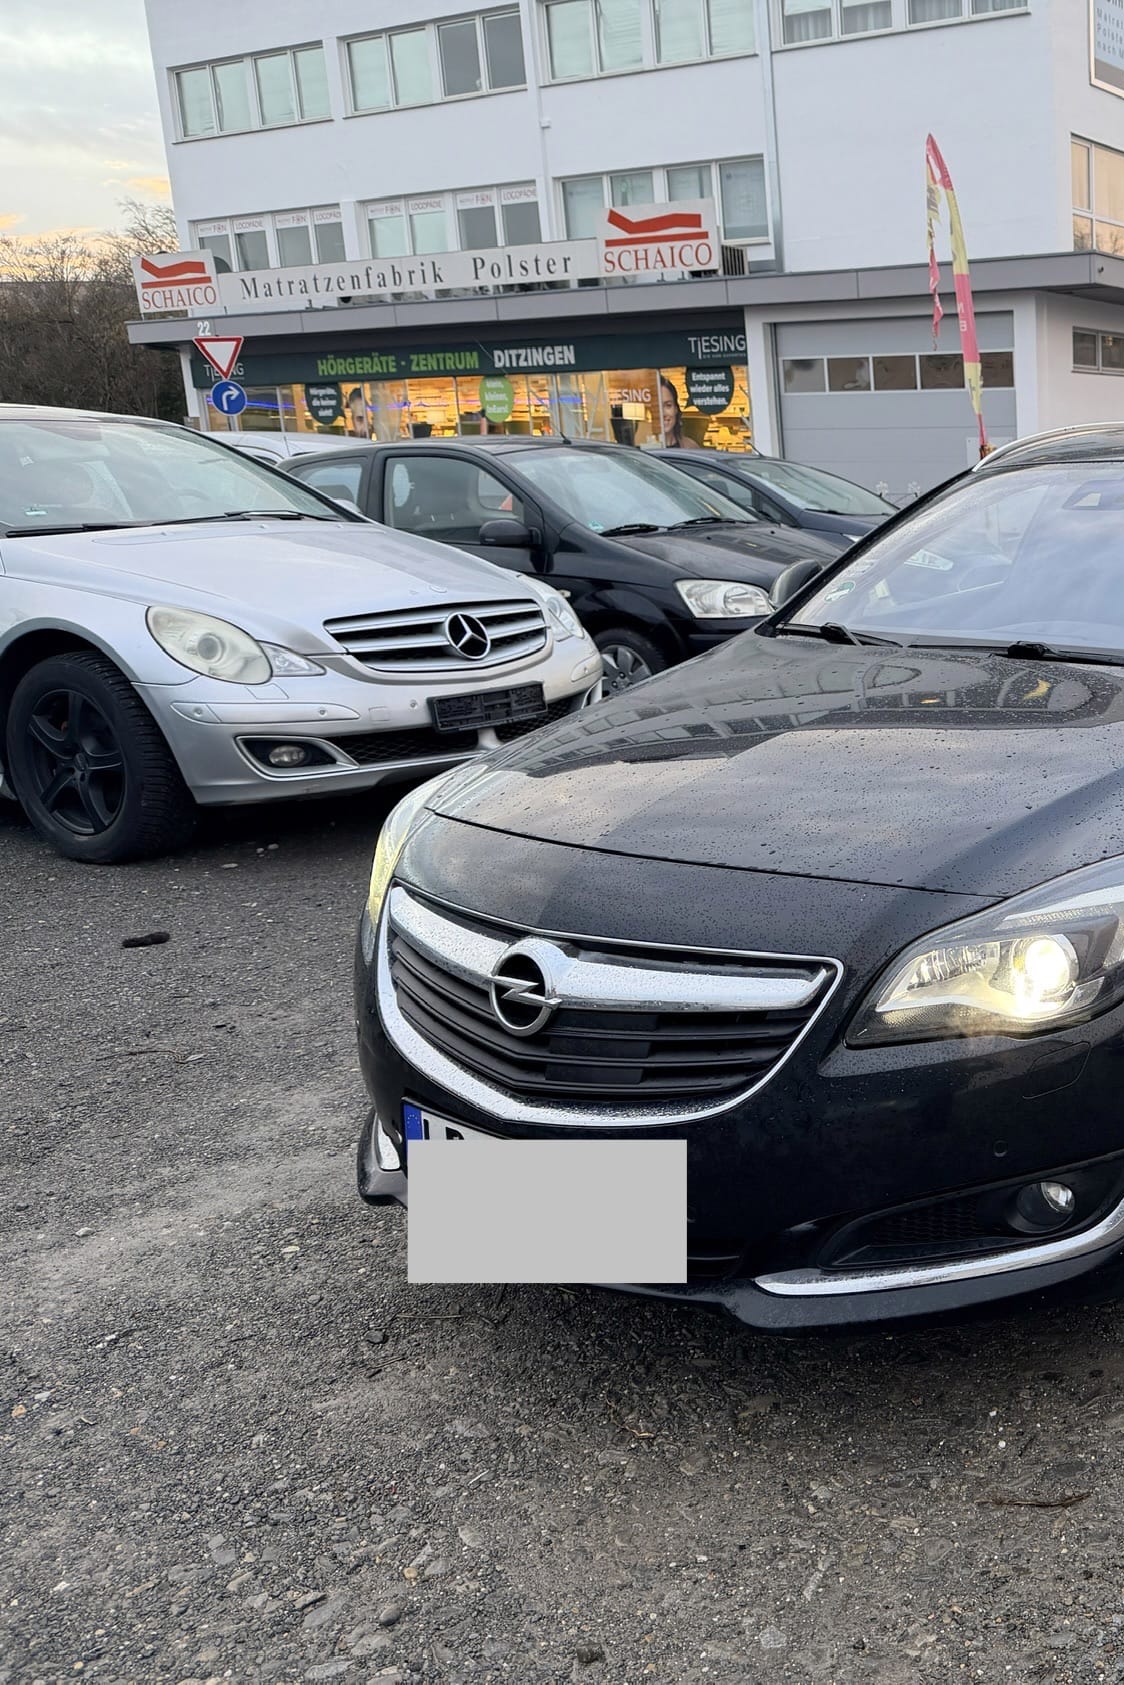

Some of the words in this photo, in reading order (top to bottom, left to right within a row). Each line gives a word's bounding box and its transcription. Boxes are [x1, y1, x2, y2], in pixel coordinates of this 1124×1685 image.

[604, 242, 712, 273] SCHAICO
[240, 261, 444, 300] Matratzenfabrik
[472, 254, 571, 280] Polster
[142, 285, 217, 310] SCHAICO
[197, 321, 211, 336] 22
[317, 353, 397, 376] HÖRGERÄTE
[410, 351, 479, 372] ZENTRUM
[493, 345, 575, 368] DITZINGEN
